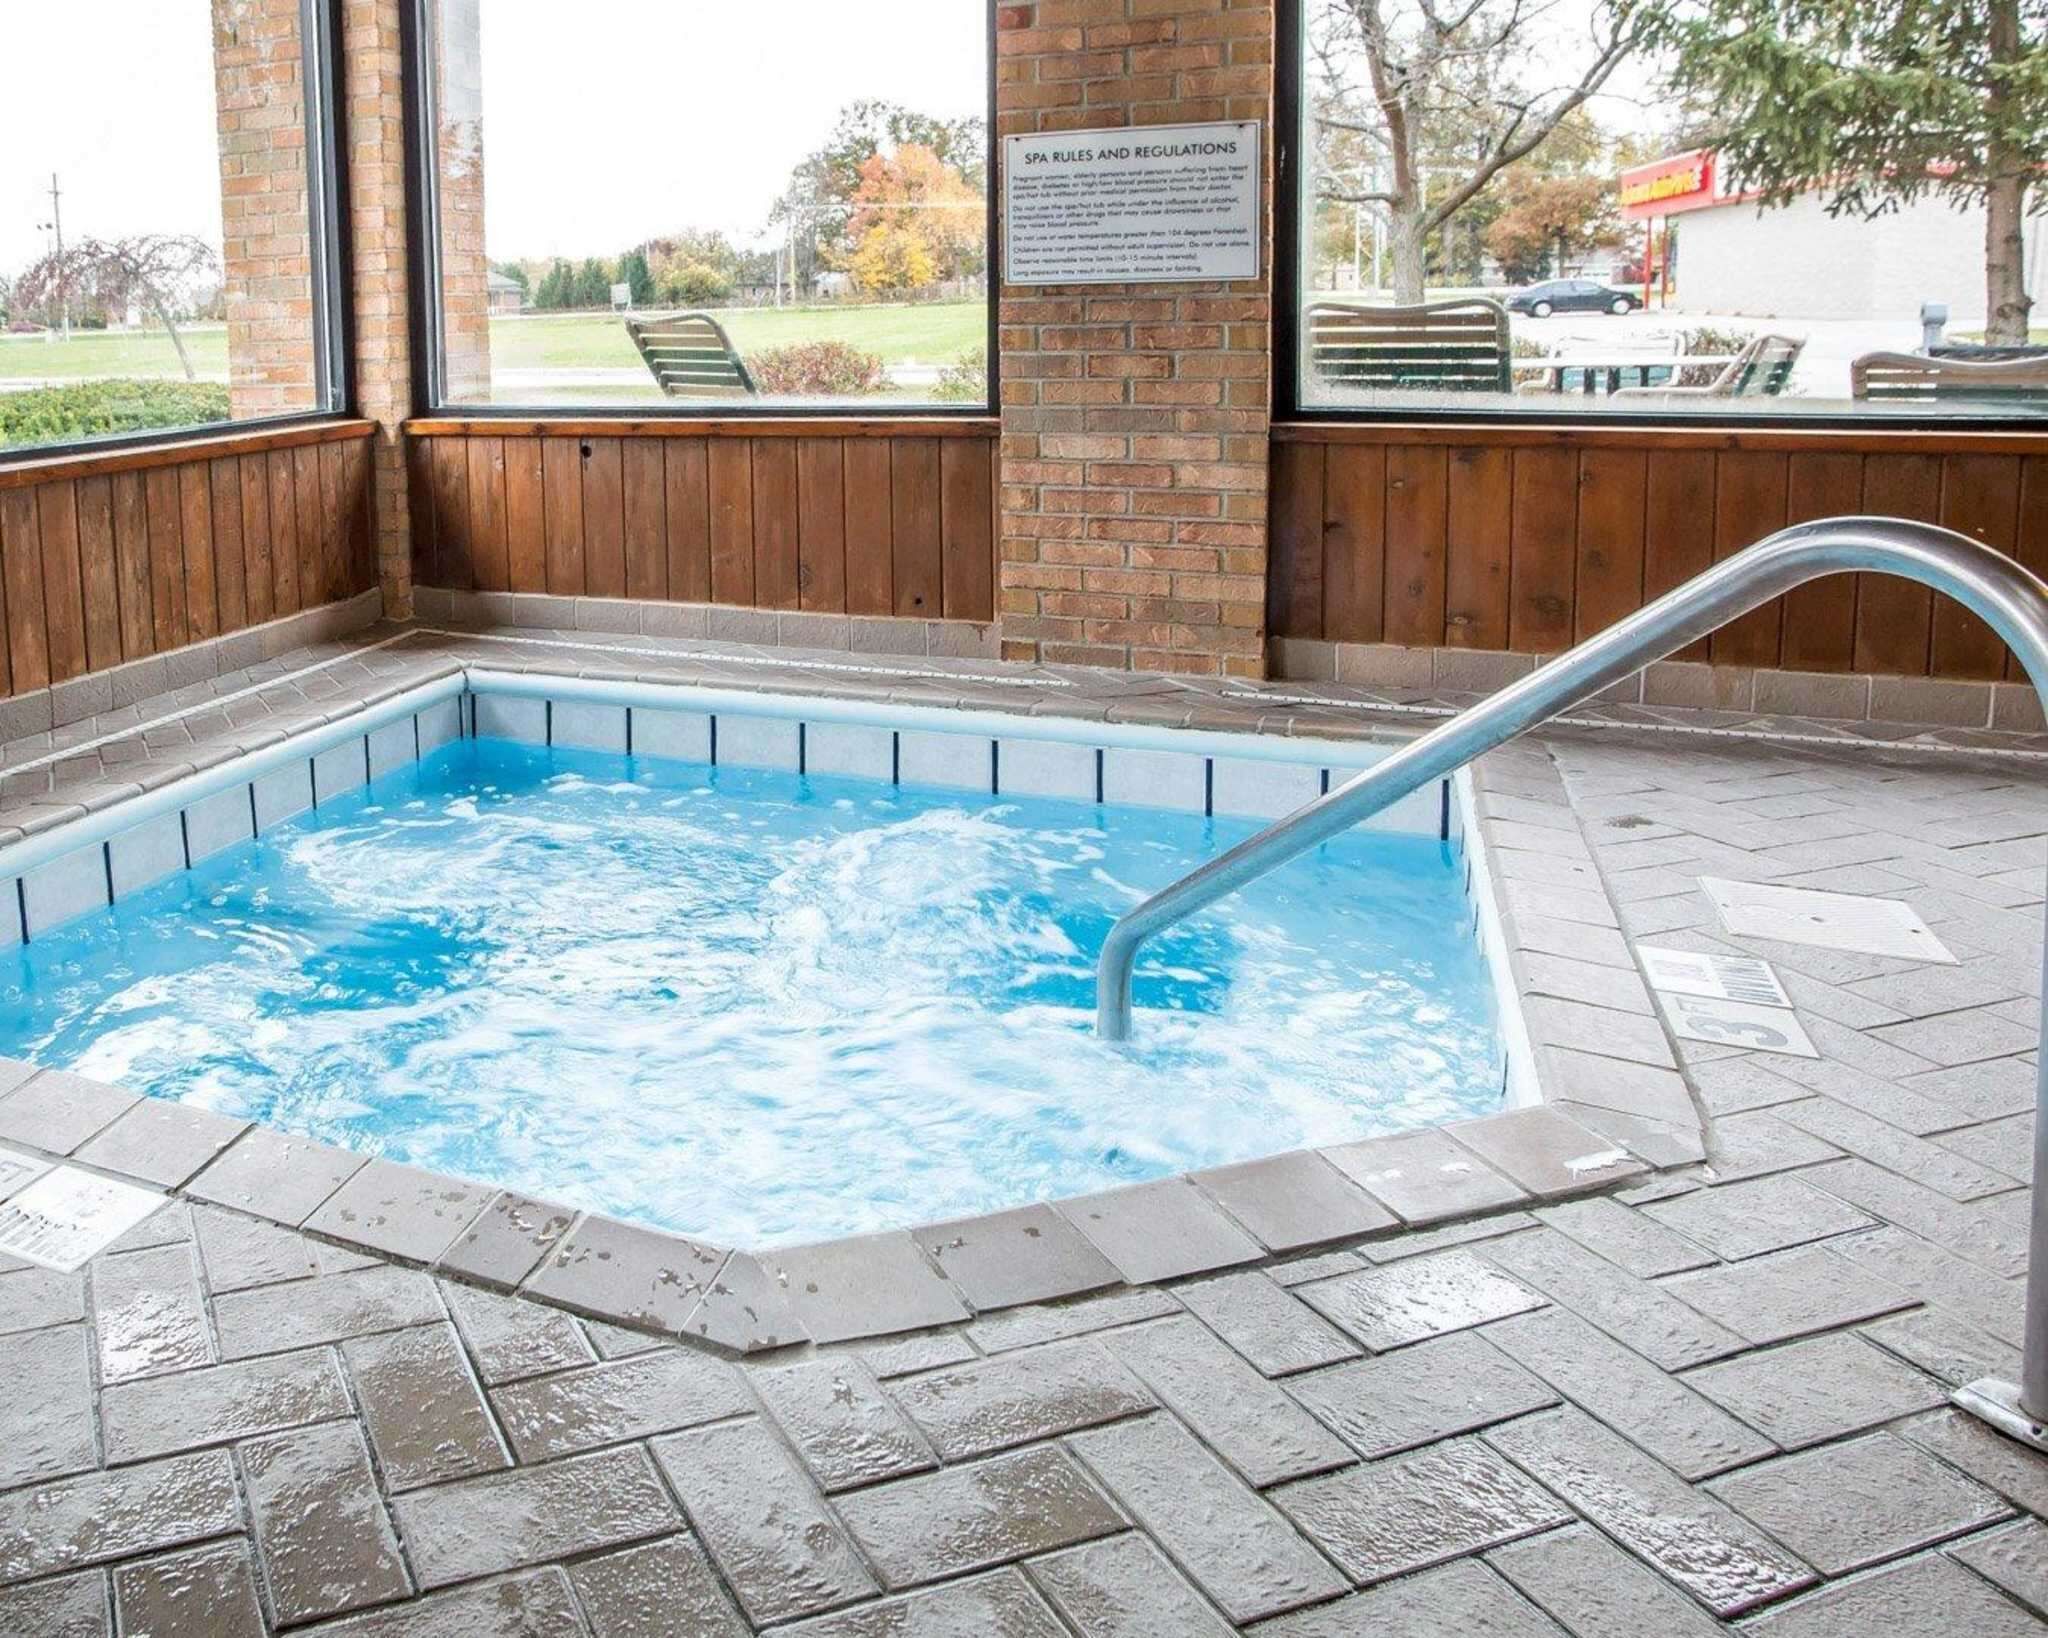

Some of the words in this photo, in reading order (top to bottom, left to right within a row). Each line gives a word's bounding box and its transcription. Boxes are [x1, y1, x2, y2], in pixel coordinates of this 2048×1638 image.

[1025, 151, 1048, 164] SPA
[1052, 149, 1093, 163] RULES
[1098, 147, 1130, 161] AND
[1135, 141, 1237, 159] REGULATIONS
[1687, 1016, 1788, 1047] 3
